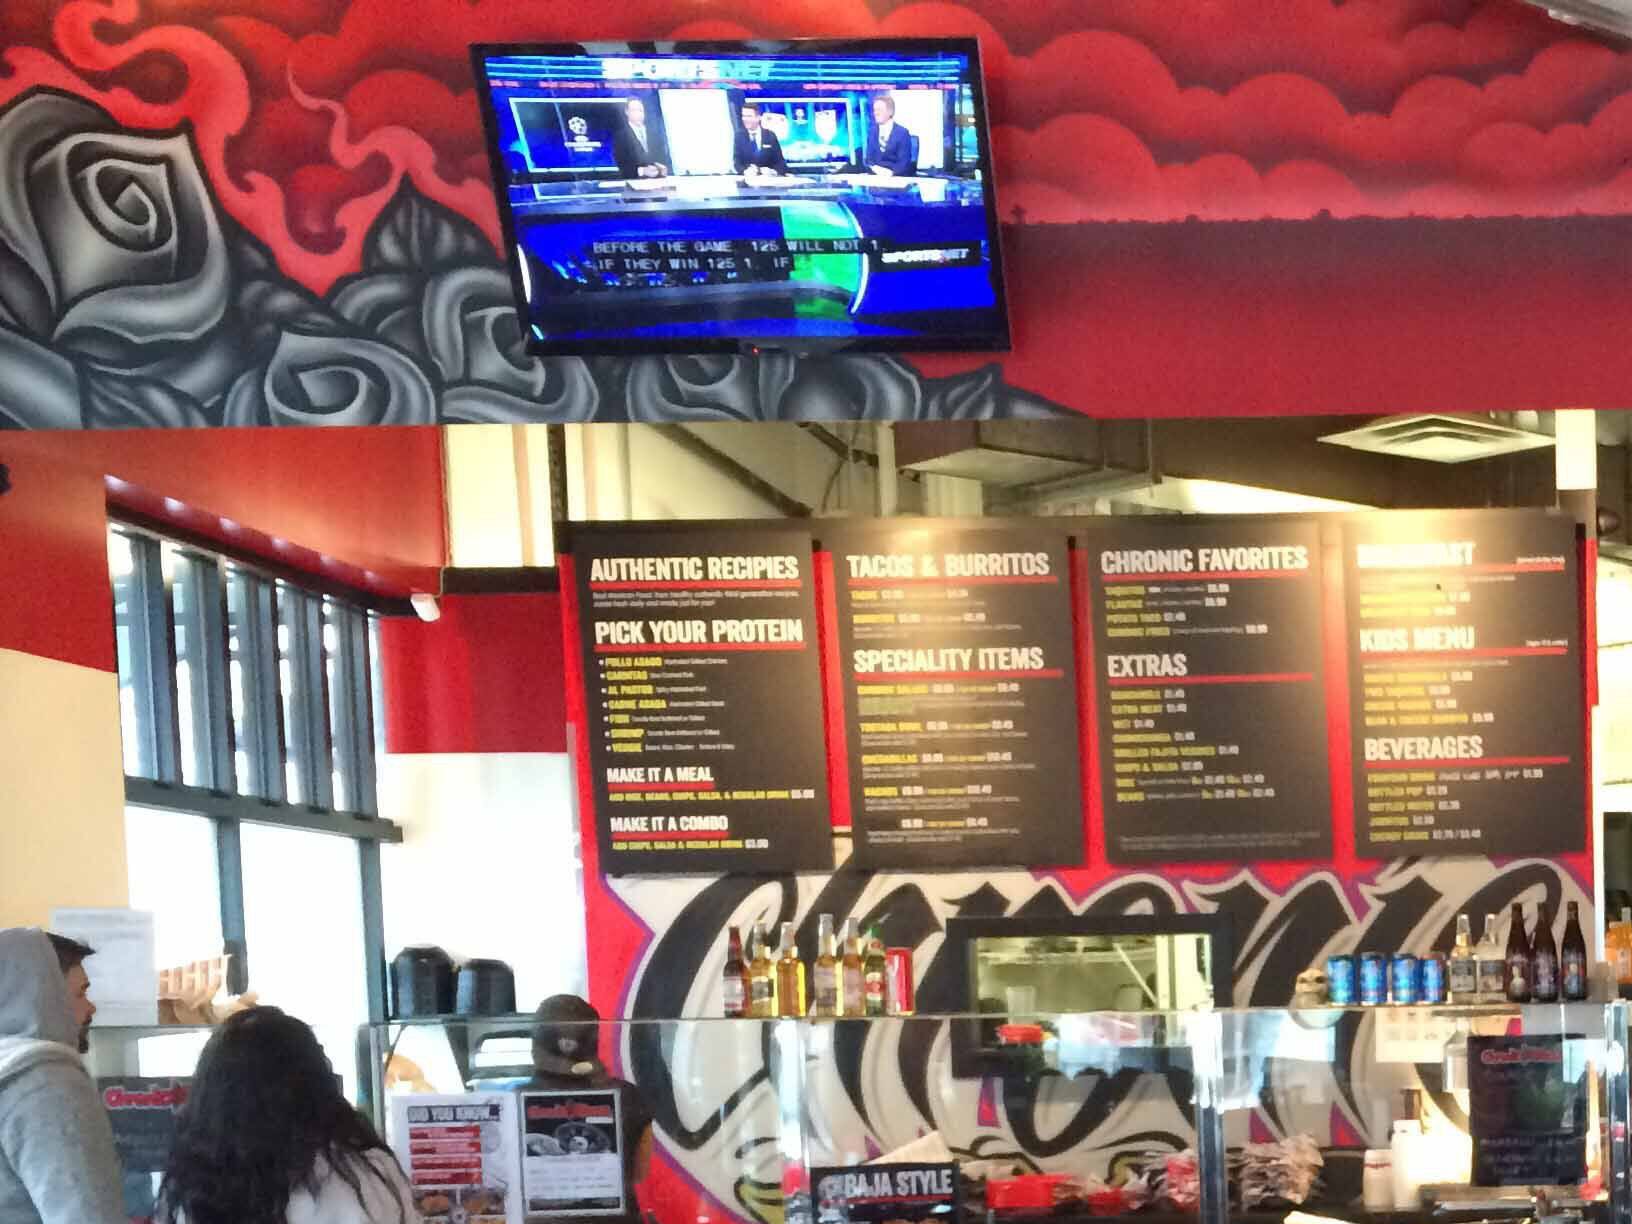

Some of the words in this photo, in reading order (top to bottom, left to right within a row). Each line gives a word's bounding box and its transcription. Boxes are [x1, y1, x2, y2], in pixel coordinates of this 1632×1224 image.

[657, 239, 691, 253] THE
[786, 238, 824, 252] WILL
[833, 238, 860, 251] NOT
[599, 258, 616, 271] IF
[624, 257, 660, 271] THEY
[669, 257, 699, 270] WIN
[773, 256, 791, 270] IF
[590, 556, 703, 582] AUTHENTIC
[846, 553, 914, 578] TACOS
[921, 554, 939, 577] &
[944, 552, 1050, 577] BURRITOS
[1100, 549, 1194, 575] CHRONIC
[1198, 546, 1309, 572] FAVORITES
[594, 619, 645, 645] PICK
[649, 619, 707, 645] YOUR
[712, 618, 803, 643] PROTEIN
[853, 648, 973, 674] SPECIALITY
[978, 647, 1045, 672] ITEMS
[1107, 653, 1188, 678] EXTRAS
[1364, 735, 1484, 762] BEVERAGES
[606, 767, 646, 784] MAKE
[648, 767, 662, 783] IT
[664, 767, 675, 783] A
[676, 766, 715, 783] MEAL
[610, 816, 649, 833] MAKE
[651, 816, 666, 832] IT
[667, 816, 678, 832] A
[680, 815, 729, 832] COMBO
[845, 1172, 894, 1198] BAJA
[896, 1170, 953, 1196] STYLE
